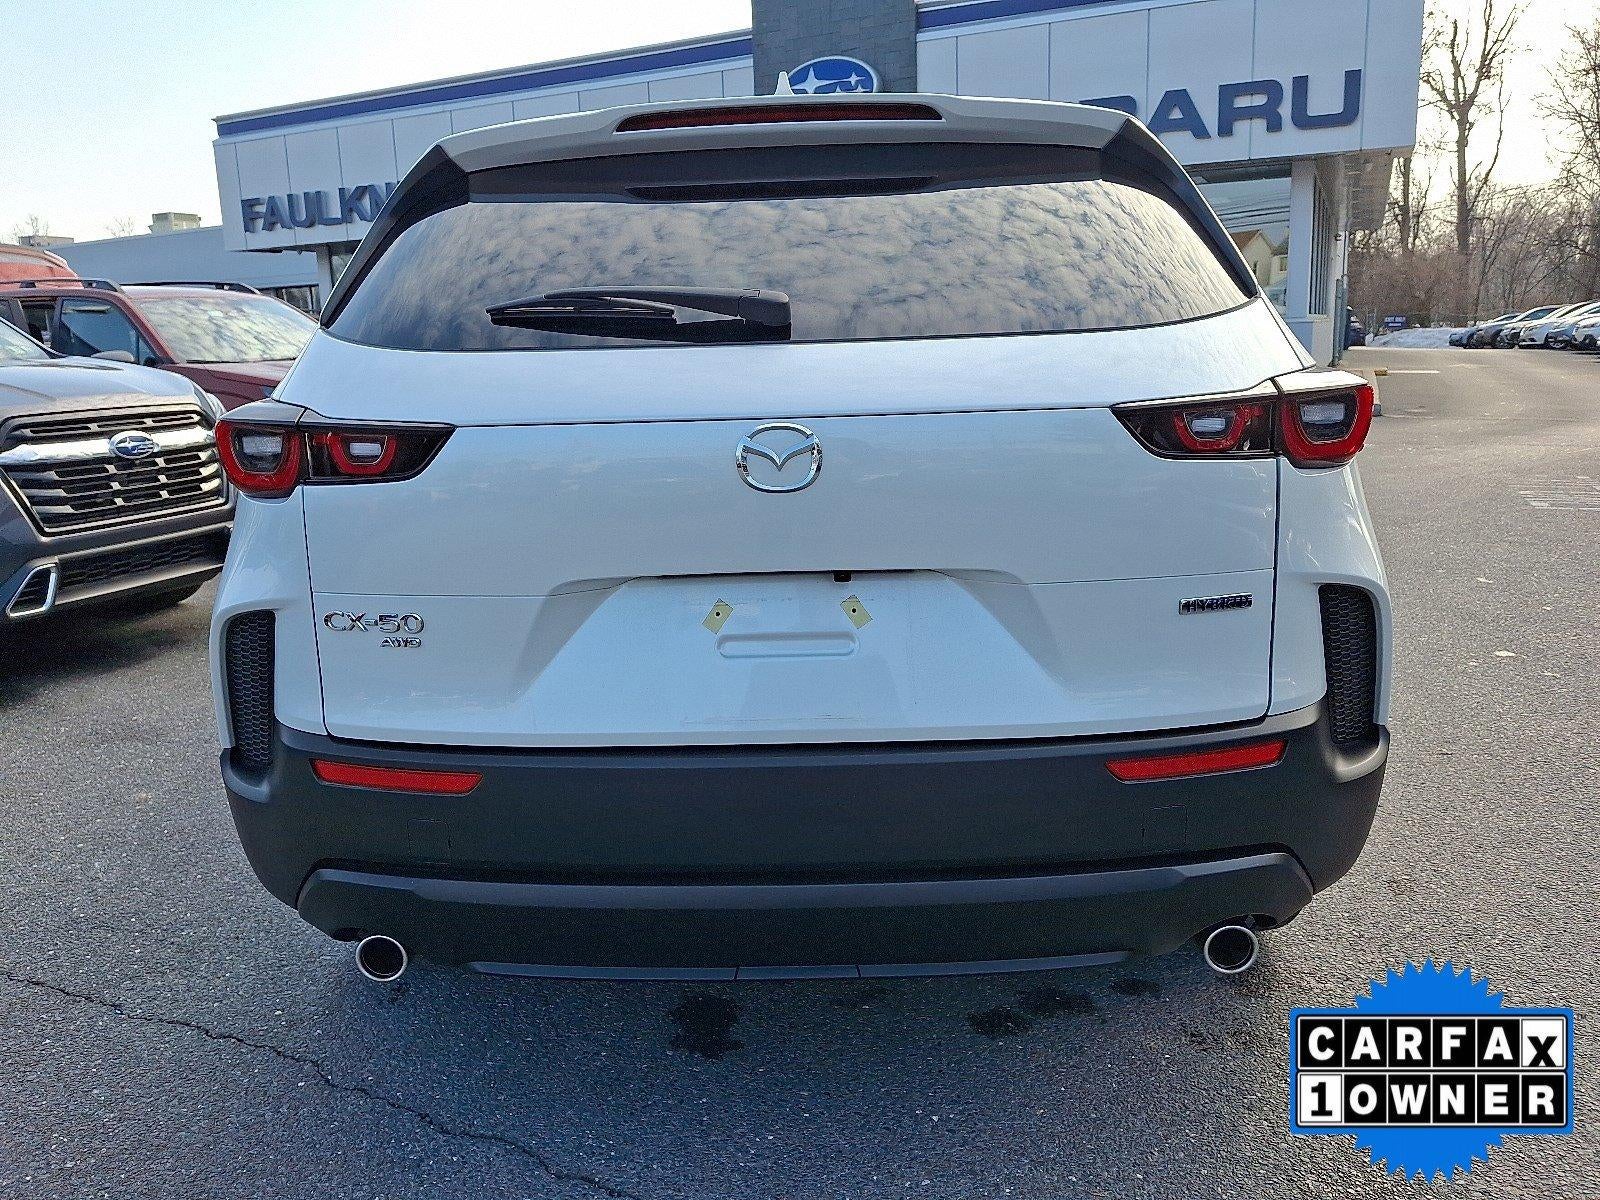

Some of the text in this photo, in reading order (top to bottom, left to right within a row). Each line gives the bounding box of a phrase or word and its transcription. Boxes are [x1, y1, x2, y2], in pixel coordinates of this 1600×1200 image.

[241, 181, 400, 233] FAULKN
[323, 611, 424, 634] CX-50
[380, 637, 422, 648] AWD
